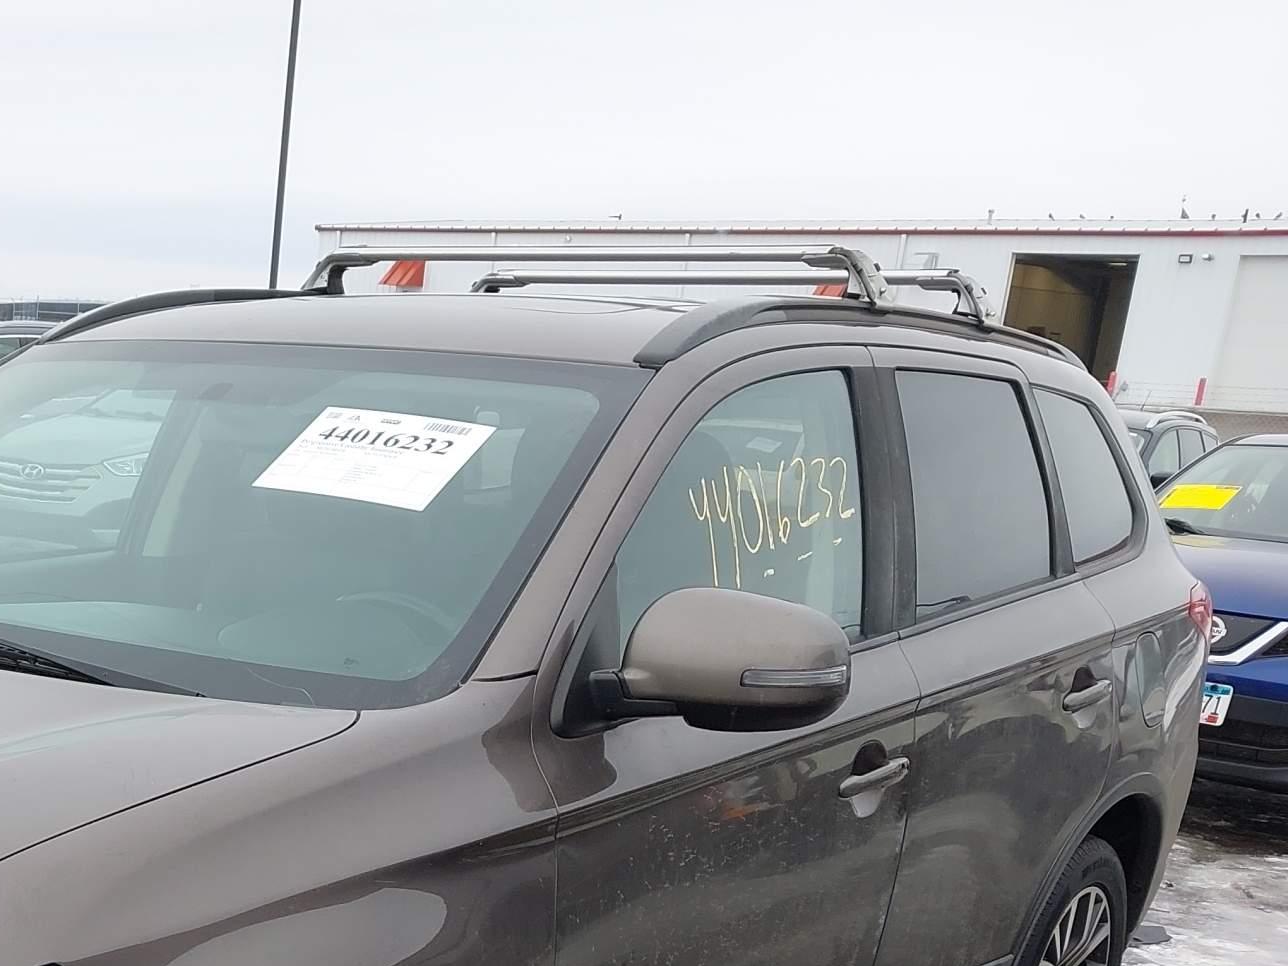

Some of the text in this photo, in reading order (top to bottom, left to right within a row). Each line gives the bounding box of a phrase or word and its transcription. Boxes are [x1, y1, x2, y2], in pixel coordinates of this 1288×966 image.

[318, 425, 454, 455] 44016232
[689, 457, 855, 588] 44016232
[1201, 694, 1221, 715] 71
